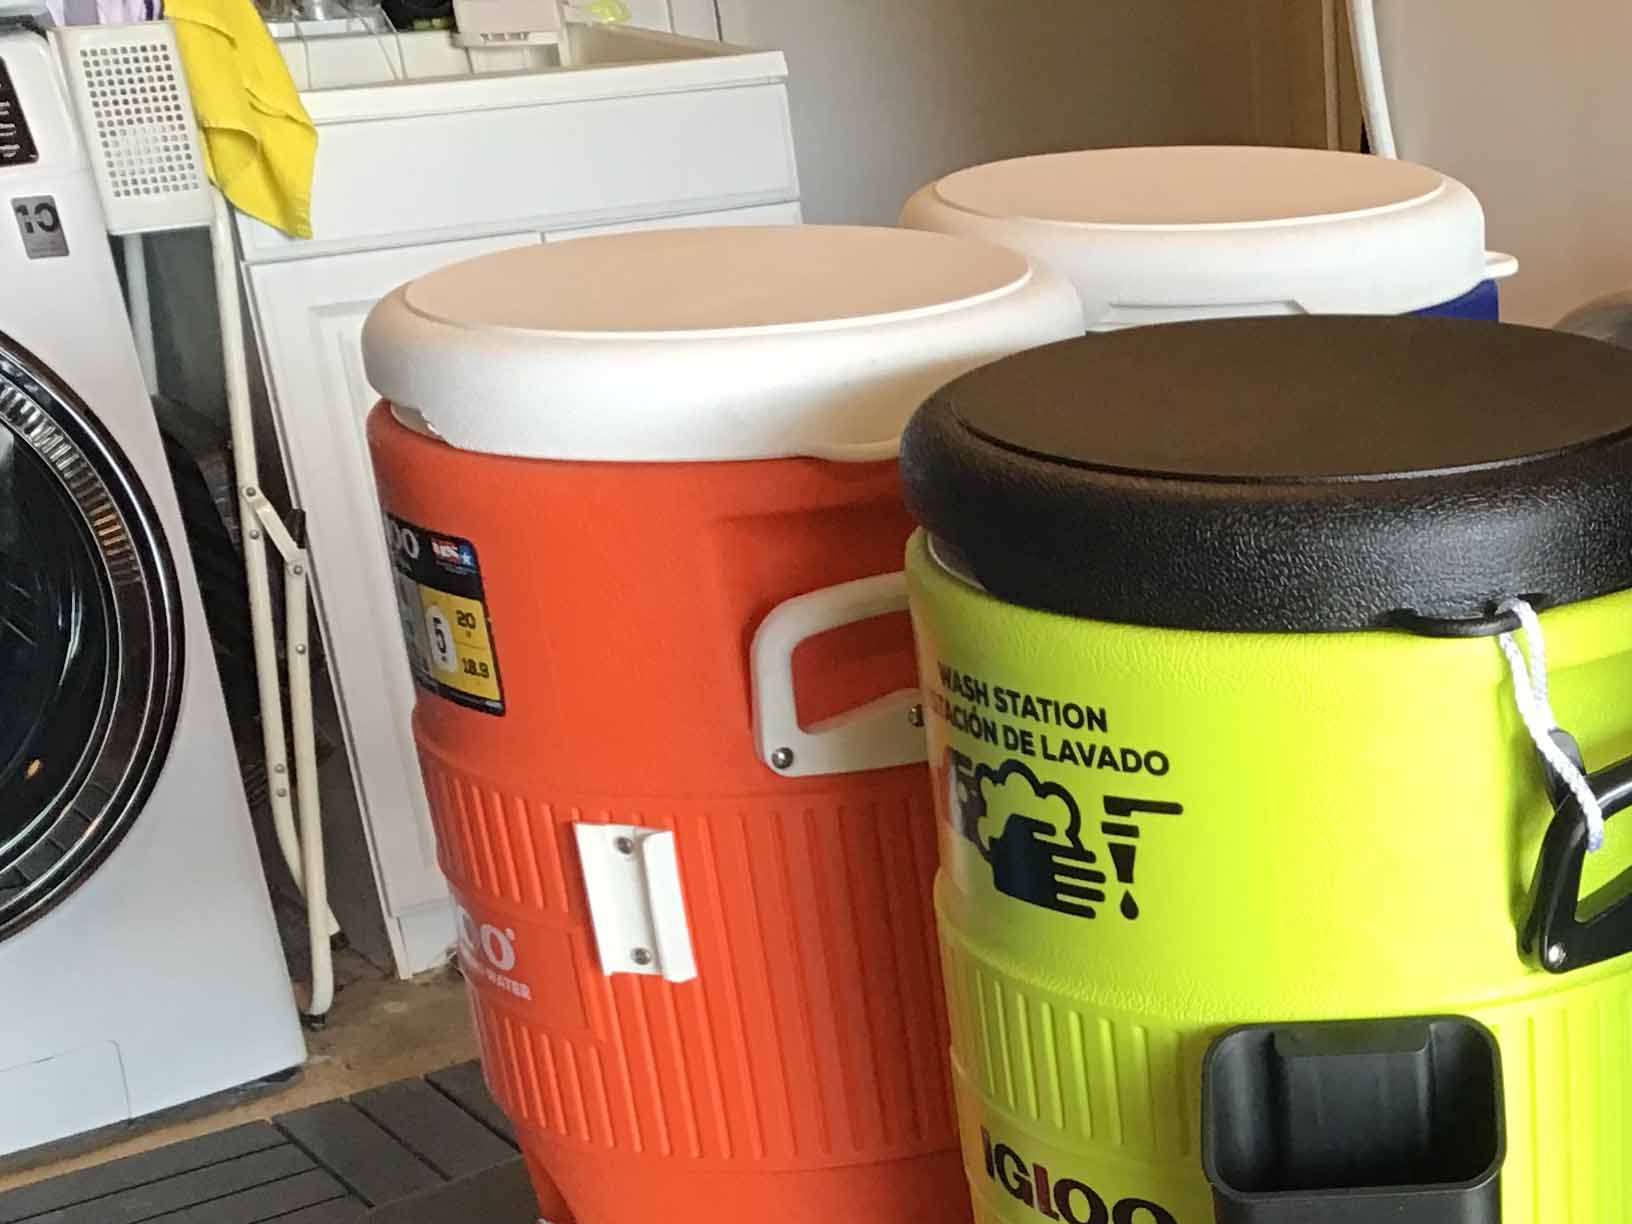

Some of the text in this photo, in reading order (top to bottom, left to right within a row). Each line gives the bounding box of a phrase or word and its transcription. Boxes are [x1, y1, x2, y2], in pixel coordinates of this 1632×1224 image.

[16, 202, 59, 233] 10
[432, 616, 448, 654] 5
[456, 610, 476, 630] 20
[462, 657, 490, 679] 18.9
[937, 661, 1108, 733] WASH STATION
[1003, 724, 1036, 757] DE
[1040, 734, 1170, 777] LAVADO
